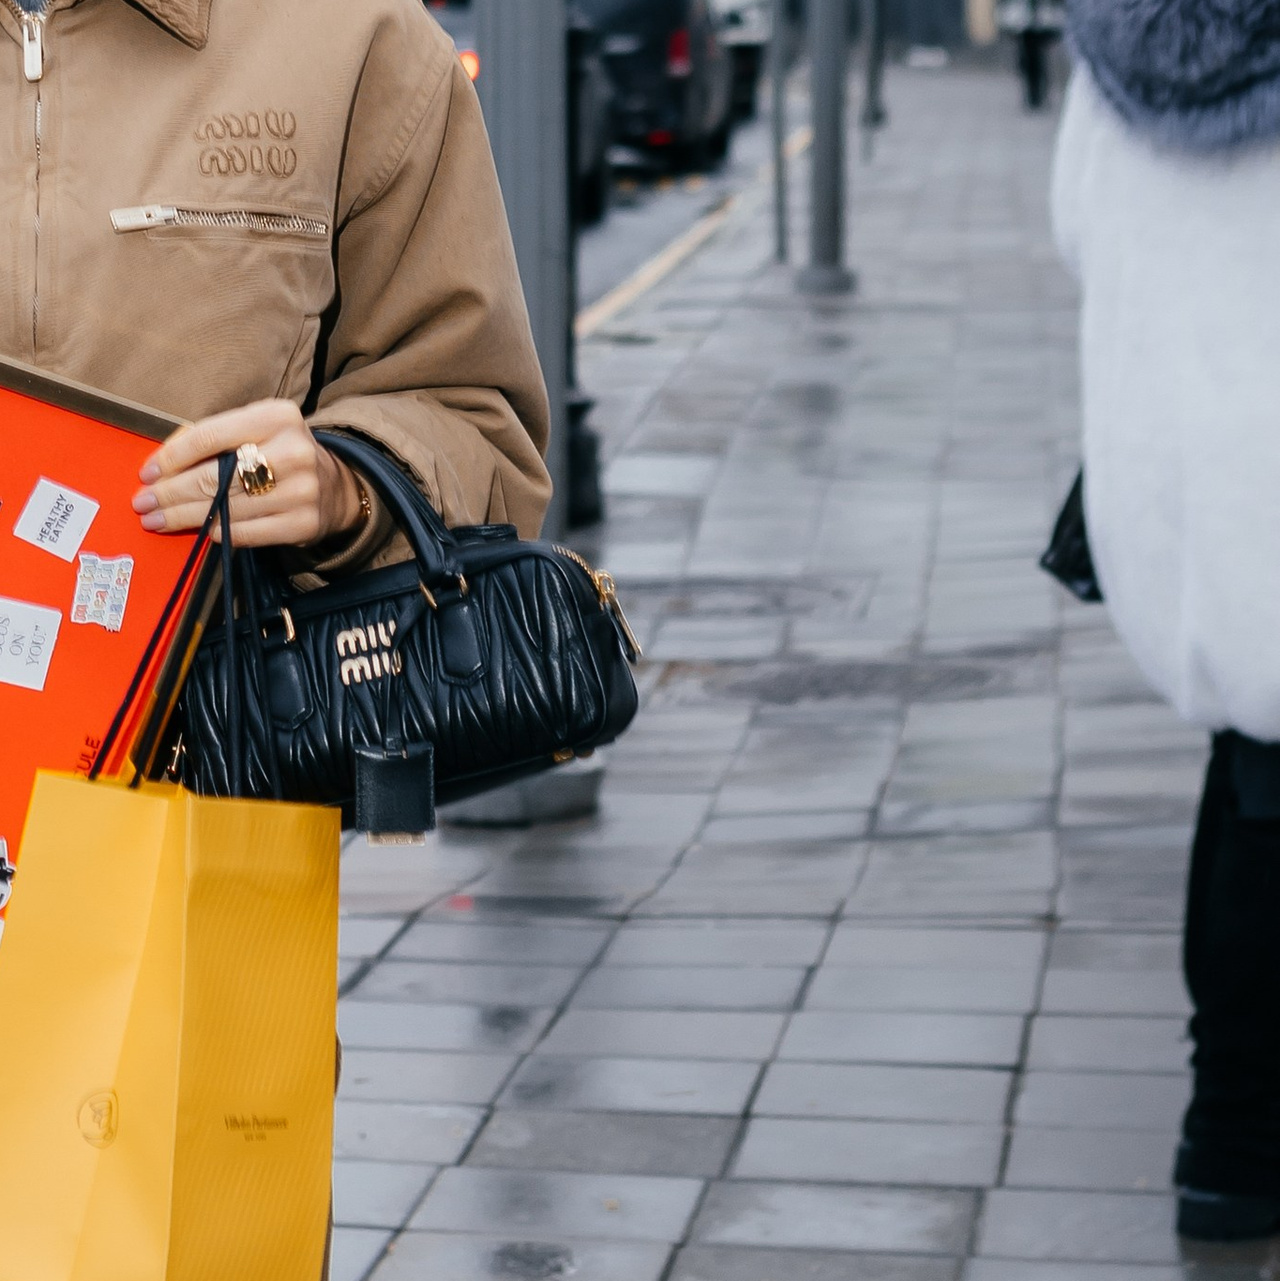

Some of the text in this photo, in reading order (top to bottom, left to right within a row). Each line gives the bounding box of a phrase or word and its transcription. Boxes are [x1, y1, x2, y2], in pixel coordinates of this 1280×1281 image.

[36, 494, 67, 543] HEALTHY
[49, 503, 75, 544] EATING
[9, 632, 26, 656] ON
